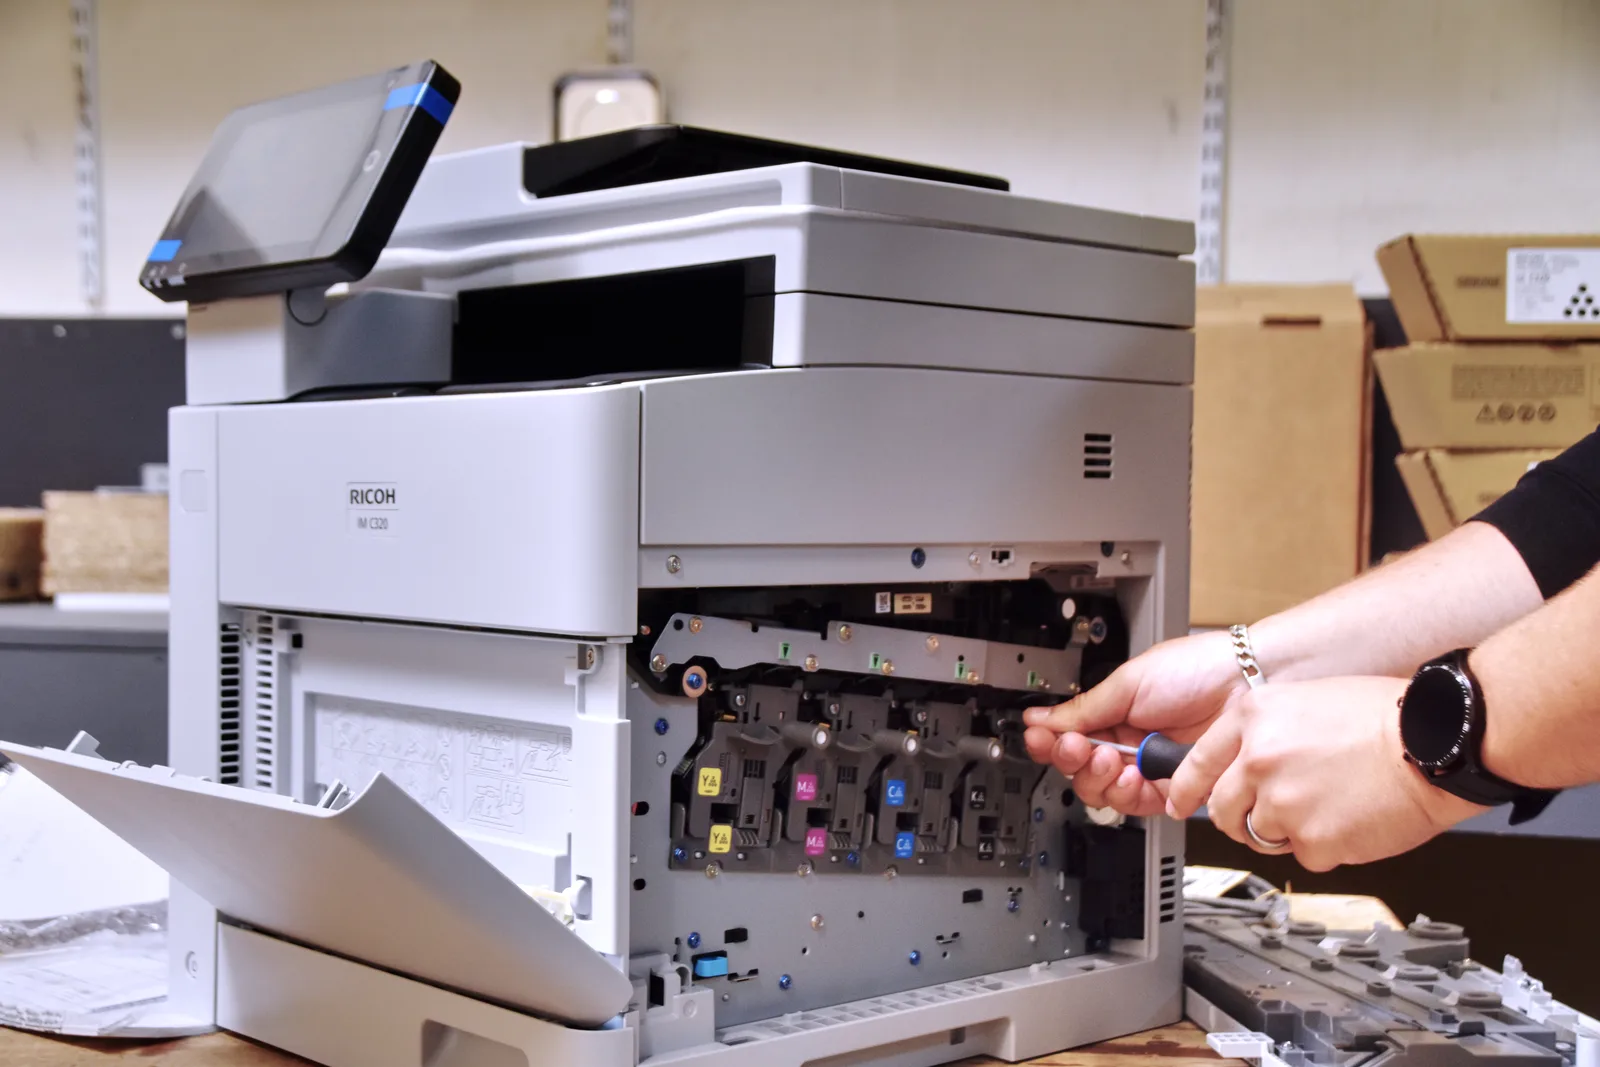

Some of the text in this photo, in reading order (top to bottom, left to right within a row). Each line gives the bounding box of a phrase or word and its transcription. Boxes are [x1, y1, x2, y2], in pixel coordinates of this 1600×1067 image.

[350, 488, 396, 504] RICOH
[357, 517, 389, 530] IM C320
[797, 781, 807, 793] M
[888, 786, 896, 798] C
[806, 836, 816, 847] M
[896, 838, 904, 850] C
